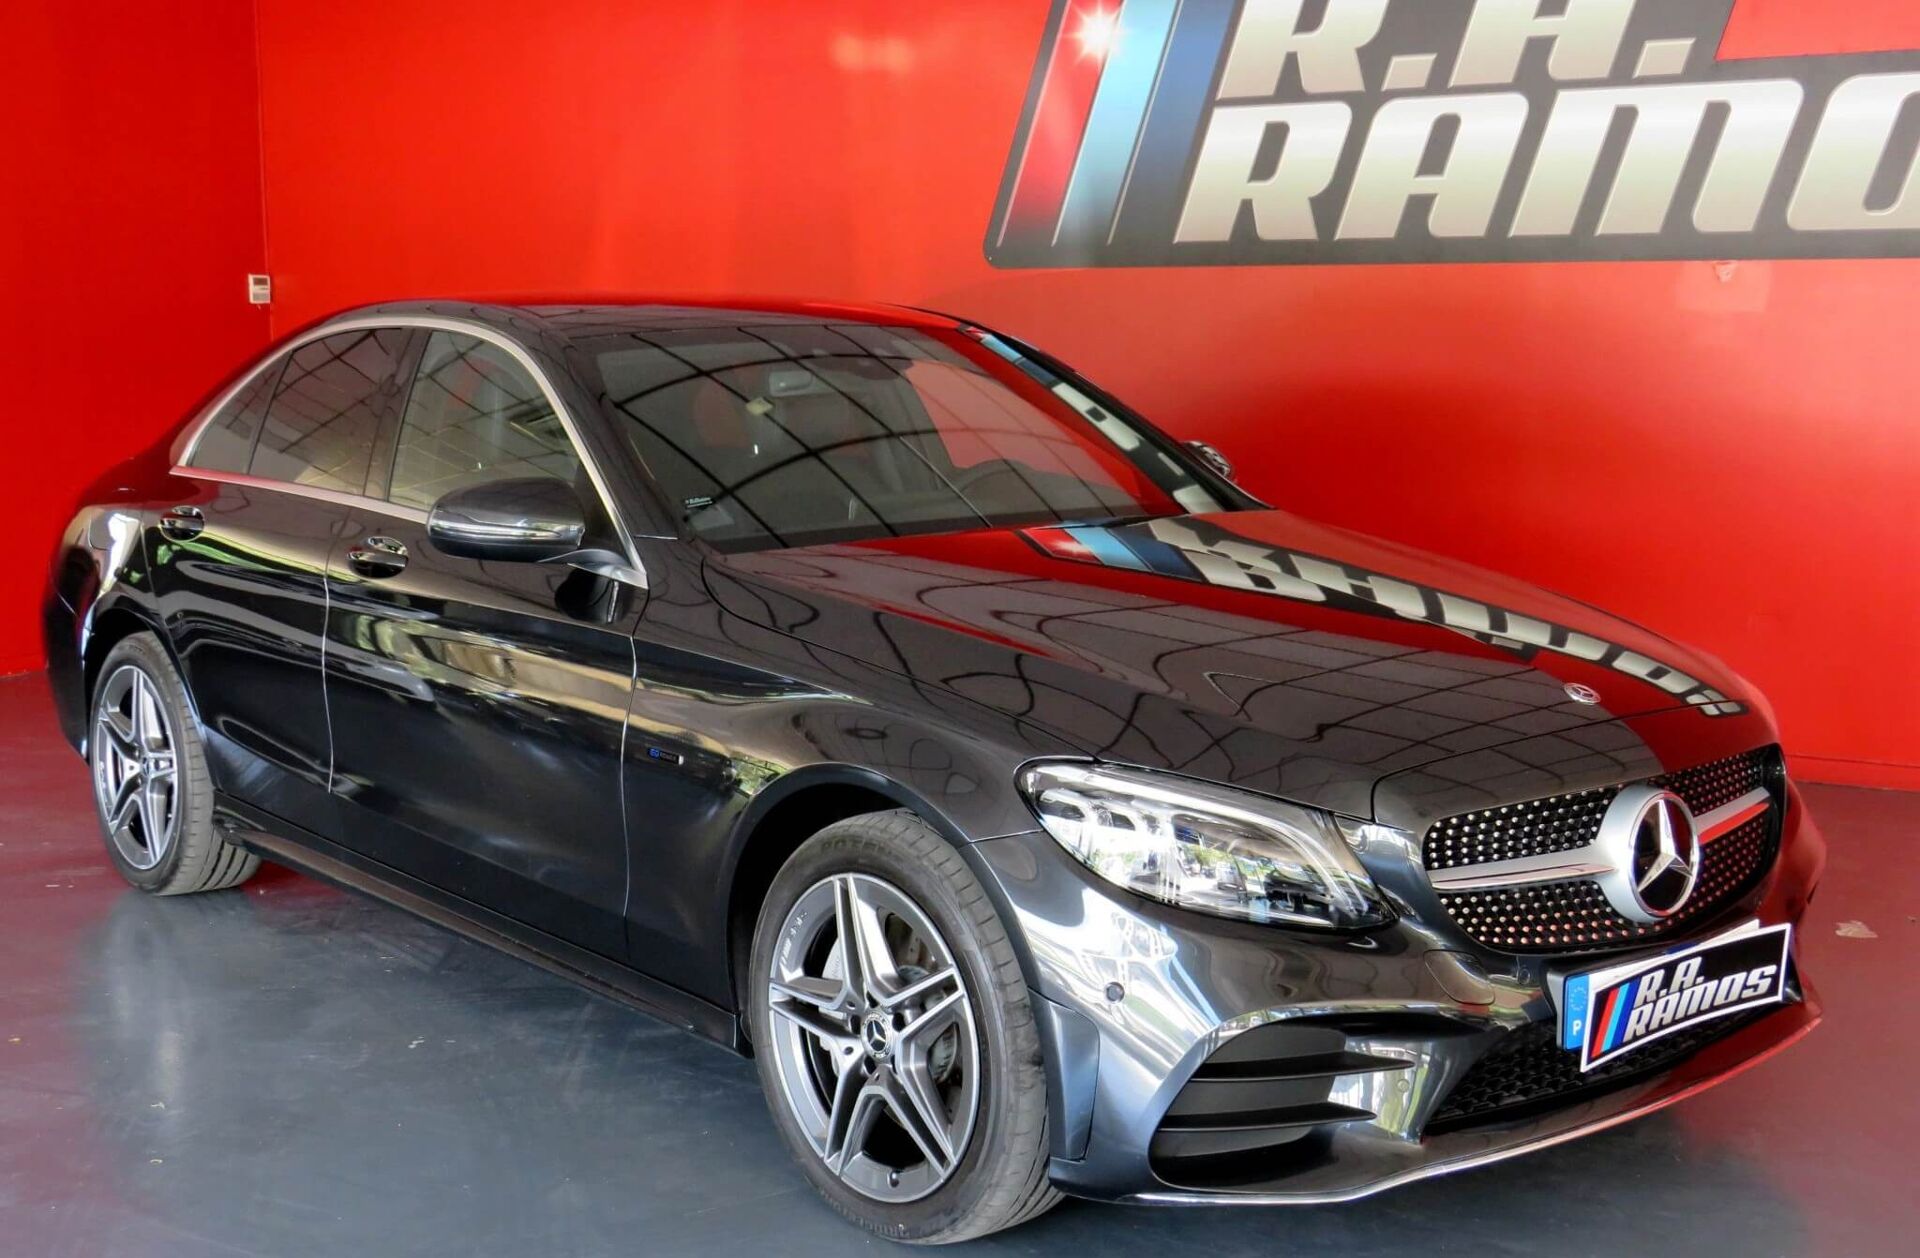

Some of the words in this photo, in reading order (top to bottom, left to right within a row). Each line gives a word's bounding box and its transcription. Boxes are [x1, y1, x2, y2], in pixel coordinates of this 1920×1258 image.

[1217, 0, 1696, 99] R.A.
[1623, 965, 1777, 1042] RAMOS
[1634, 957, 1705, 1008] R.A.
[1572, 1019, 1582, 1036] P
